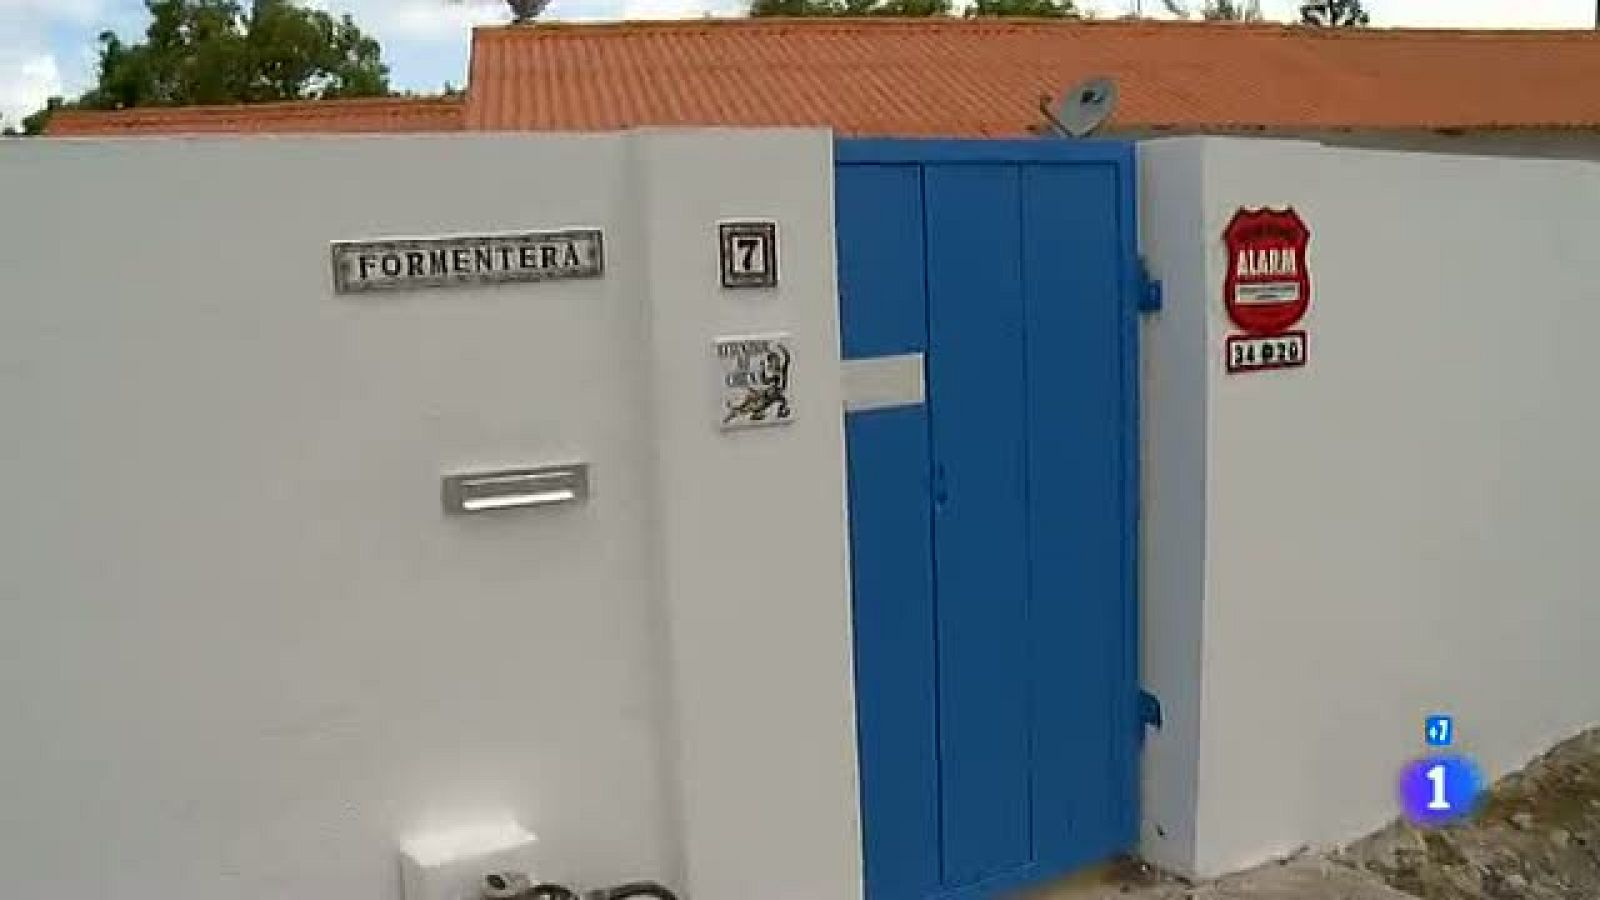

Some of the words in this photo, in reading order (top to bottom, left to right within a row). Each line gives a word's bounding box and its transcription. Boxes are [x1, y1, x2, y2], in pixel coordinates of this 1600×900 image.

[358, 242, 580, 279] FORMENTERA
[737, 238, 761, 271] 7
[1236, 247, 1297, 277] ALARM
